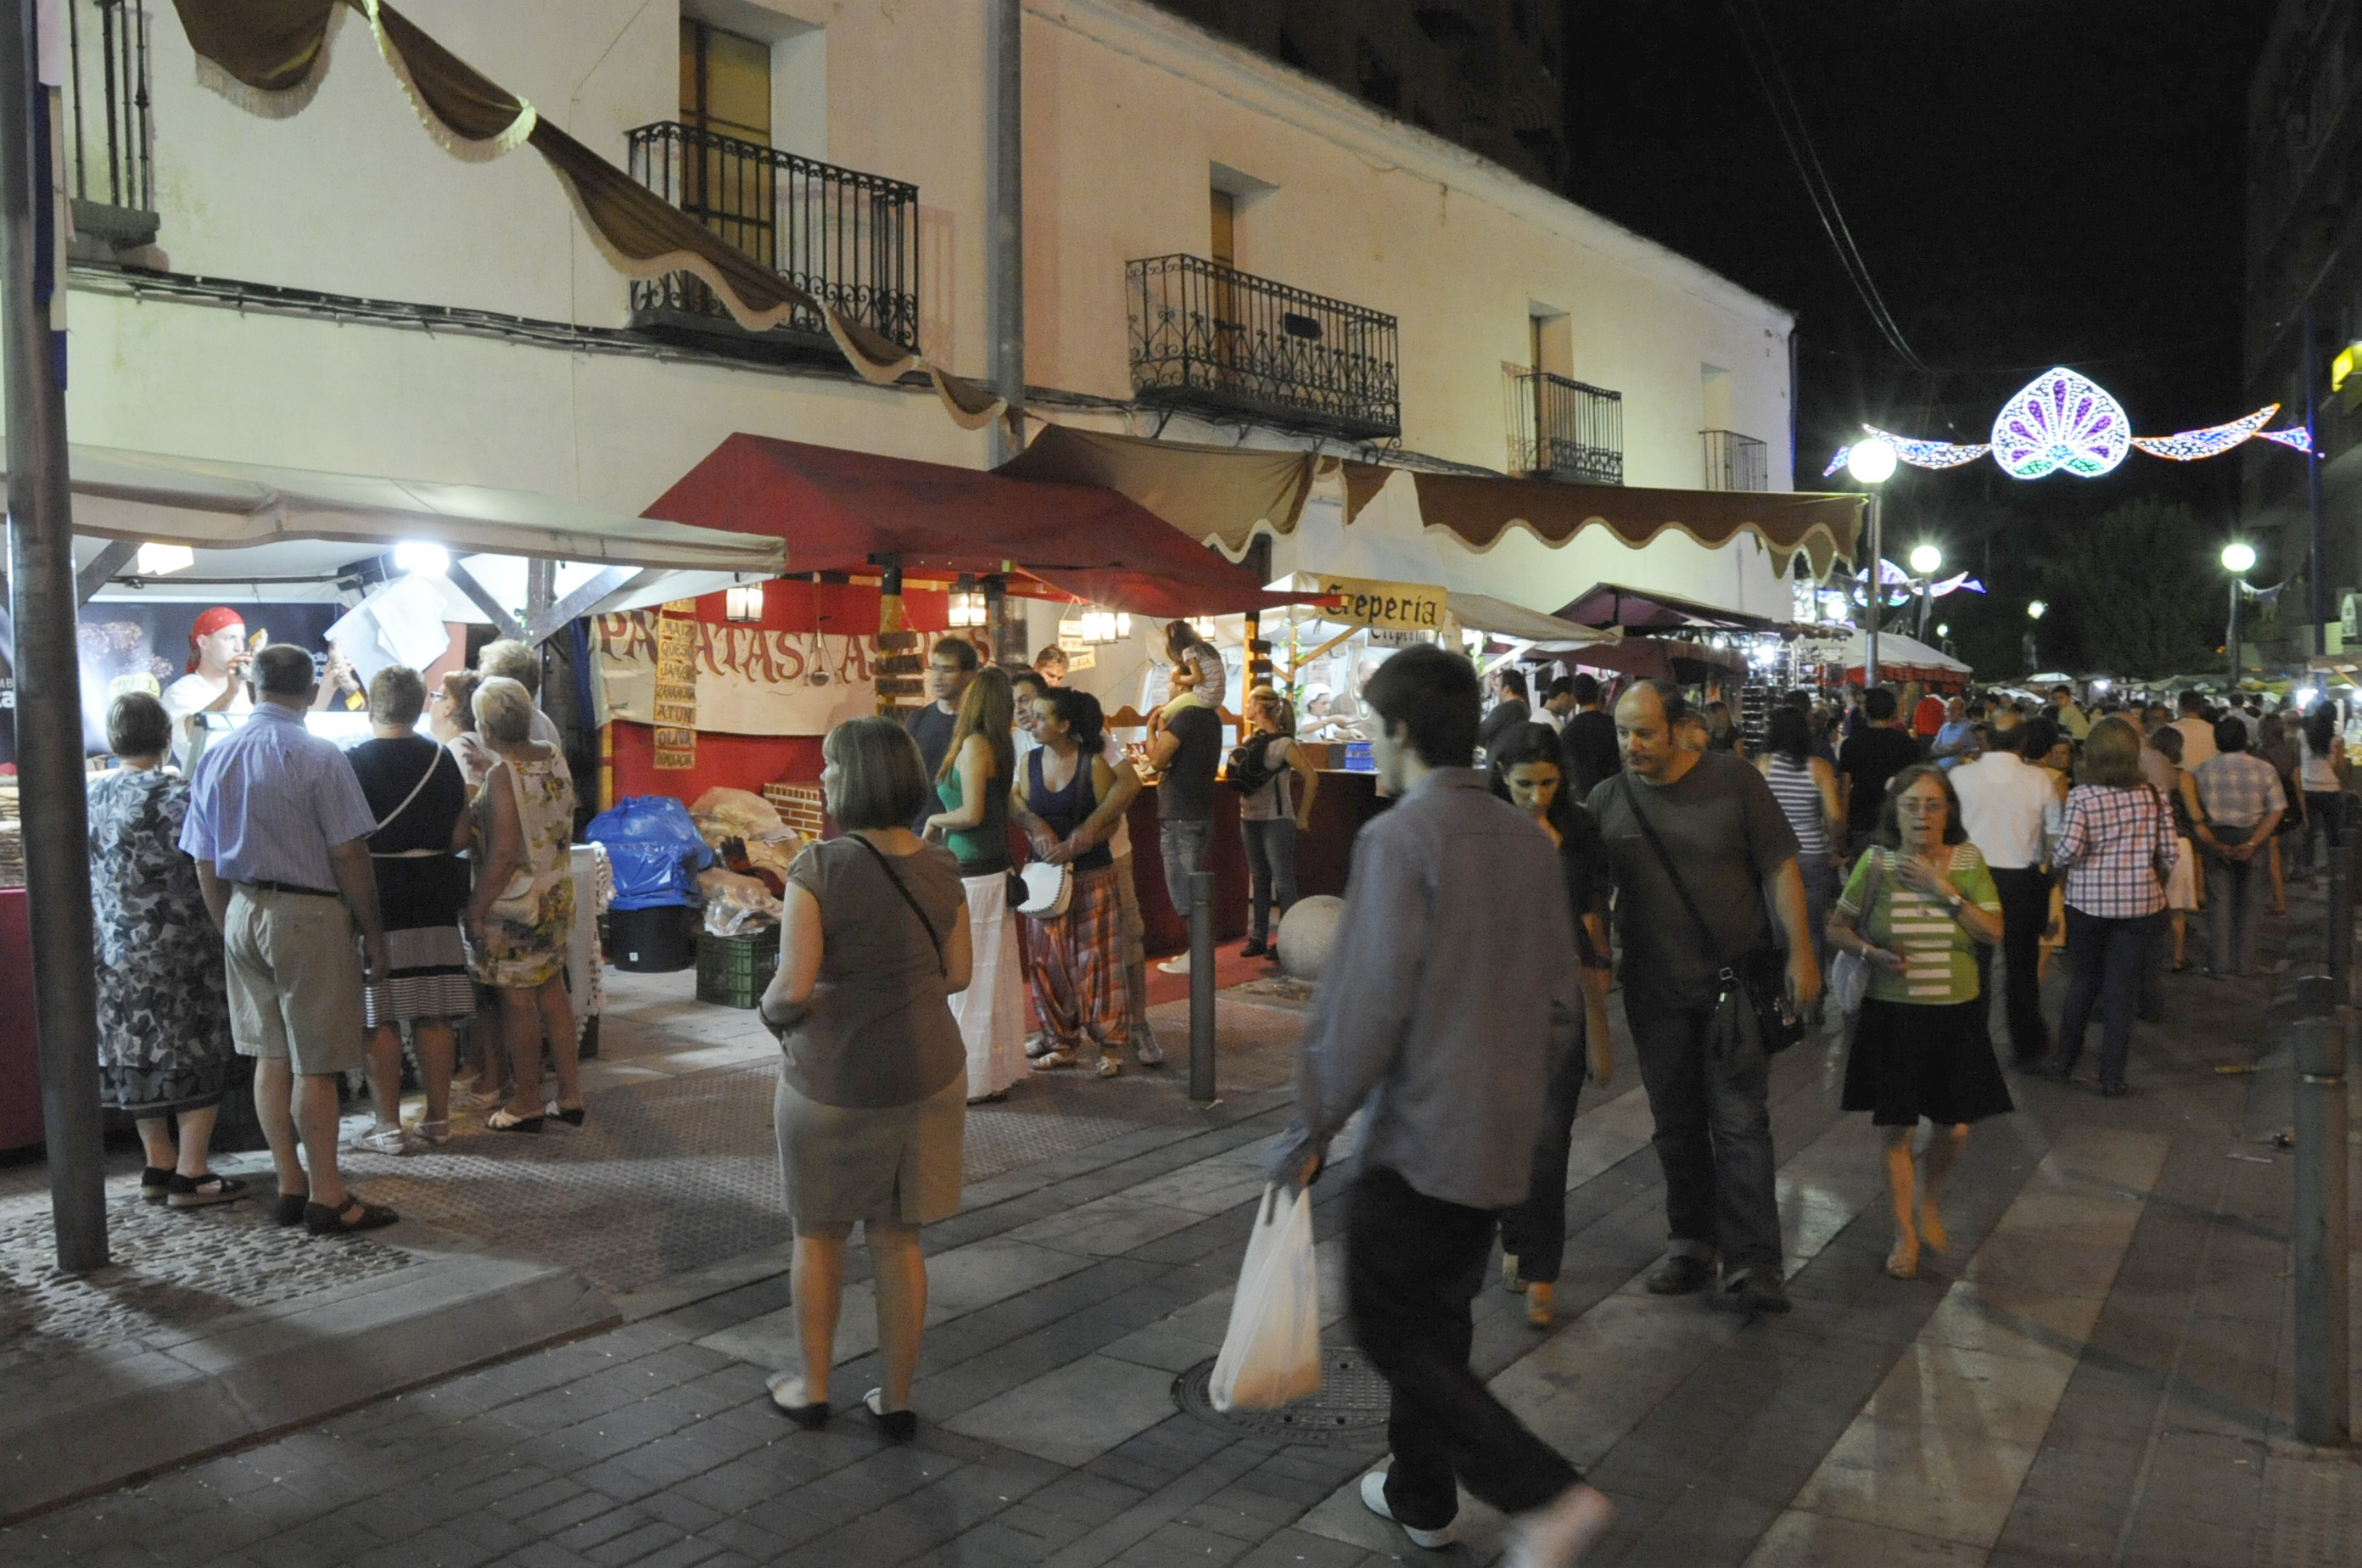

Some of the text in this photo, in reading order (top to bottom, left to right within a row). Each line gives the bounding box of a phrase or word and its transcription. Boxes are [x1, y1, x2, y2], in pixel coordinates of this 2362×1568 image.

[596, 611, 804, 684] PAATAS
[662, 641, 694, 658] QUESO
[658, 730, 691, 747] OLIVA
